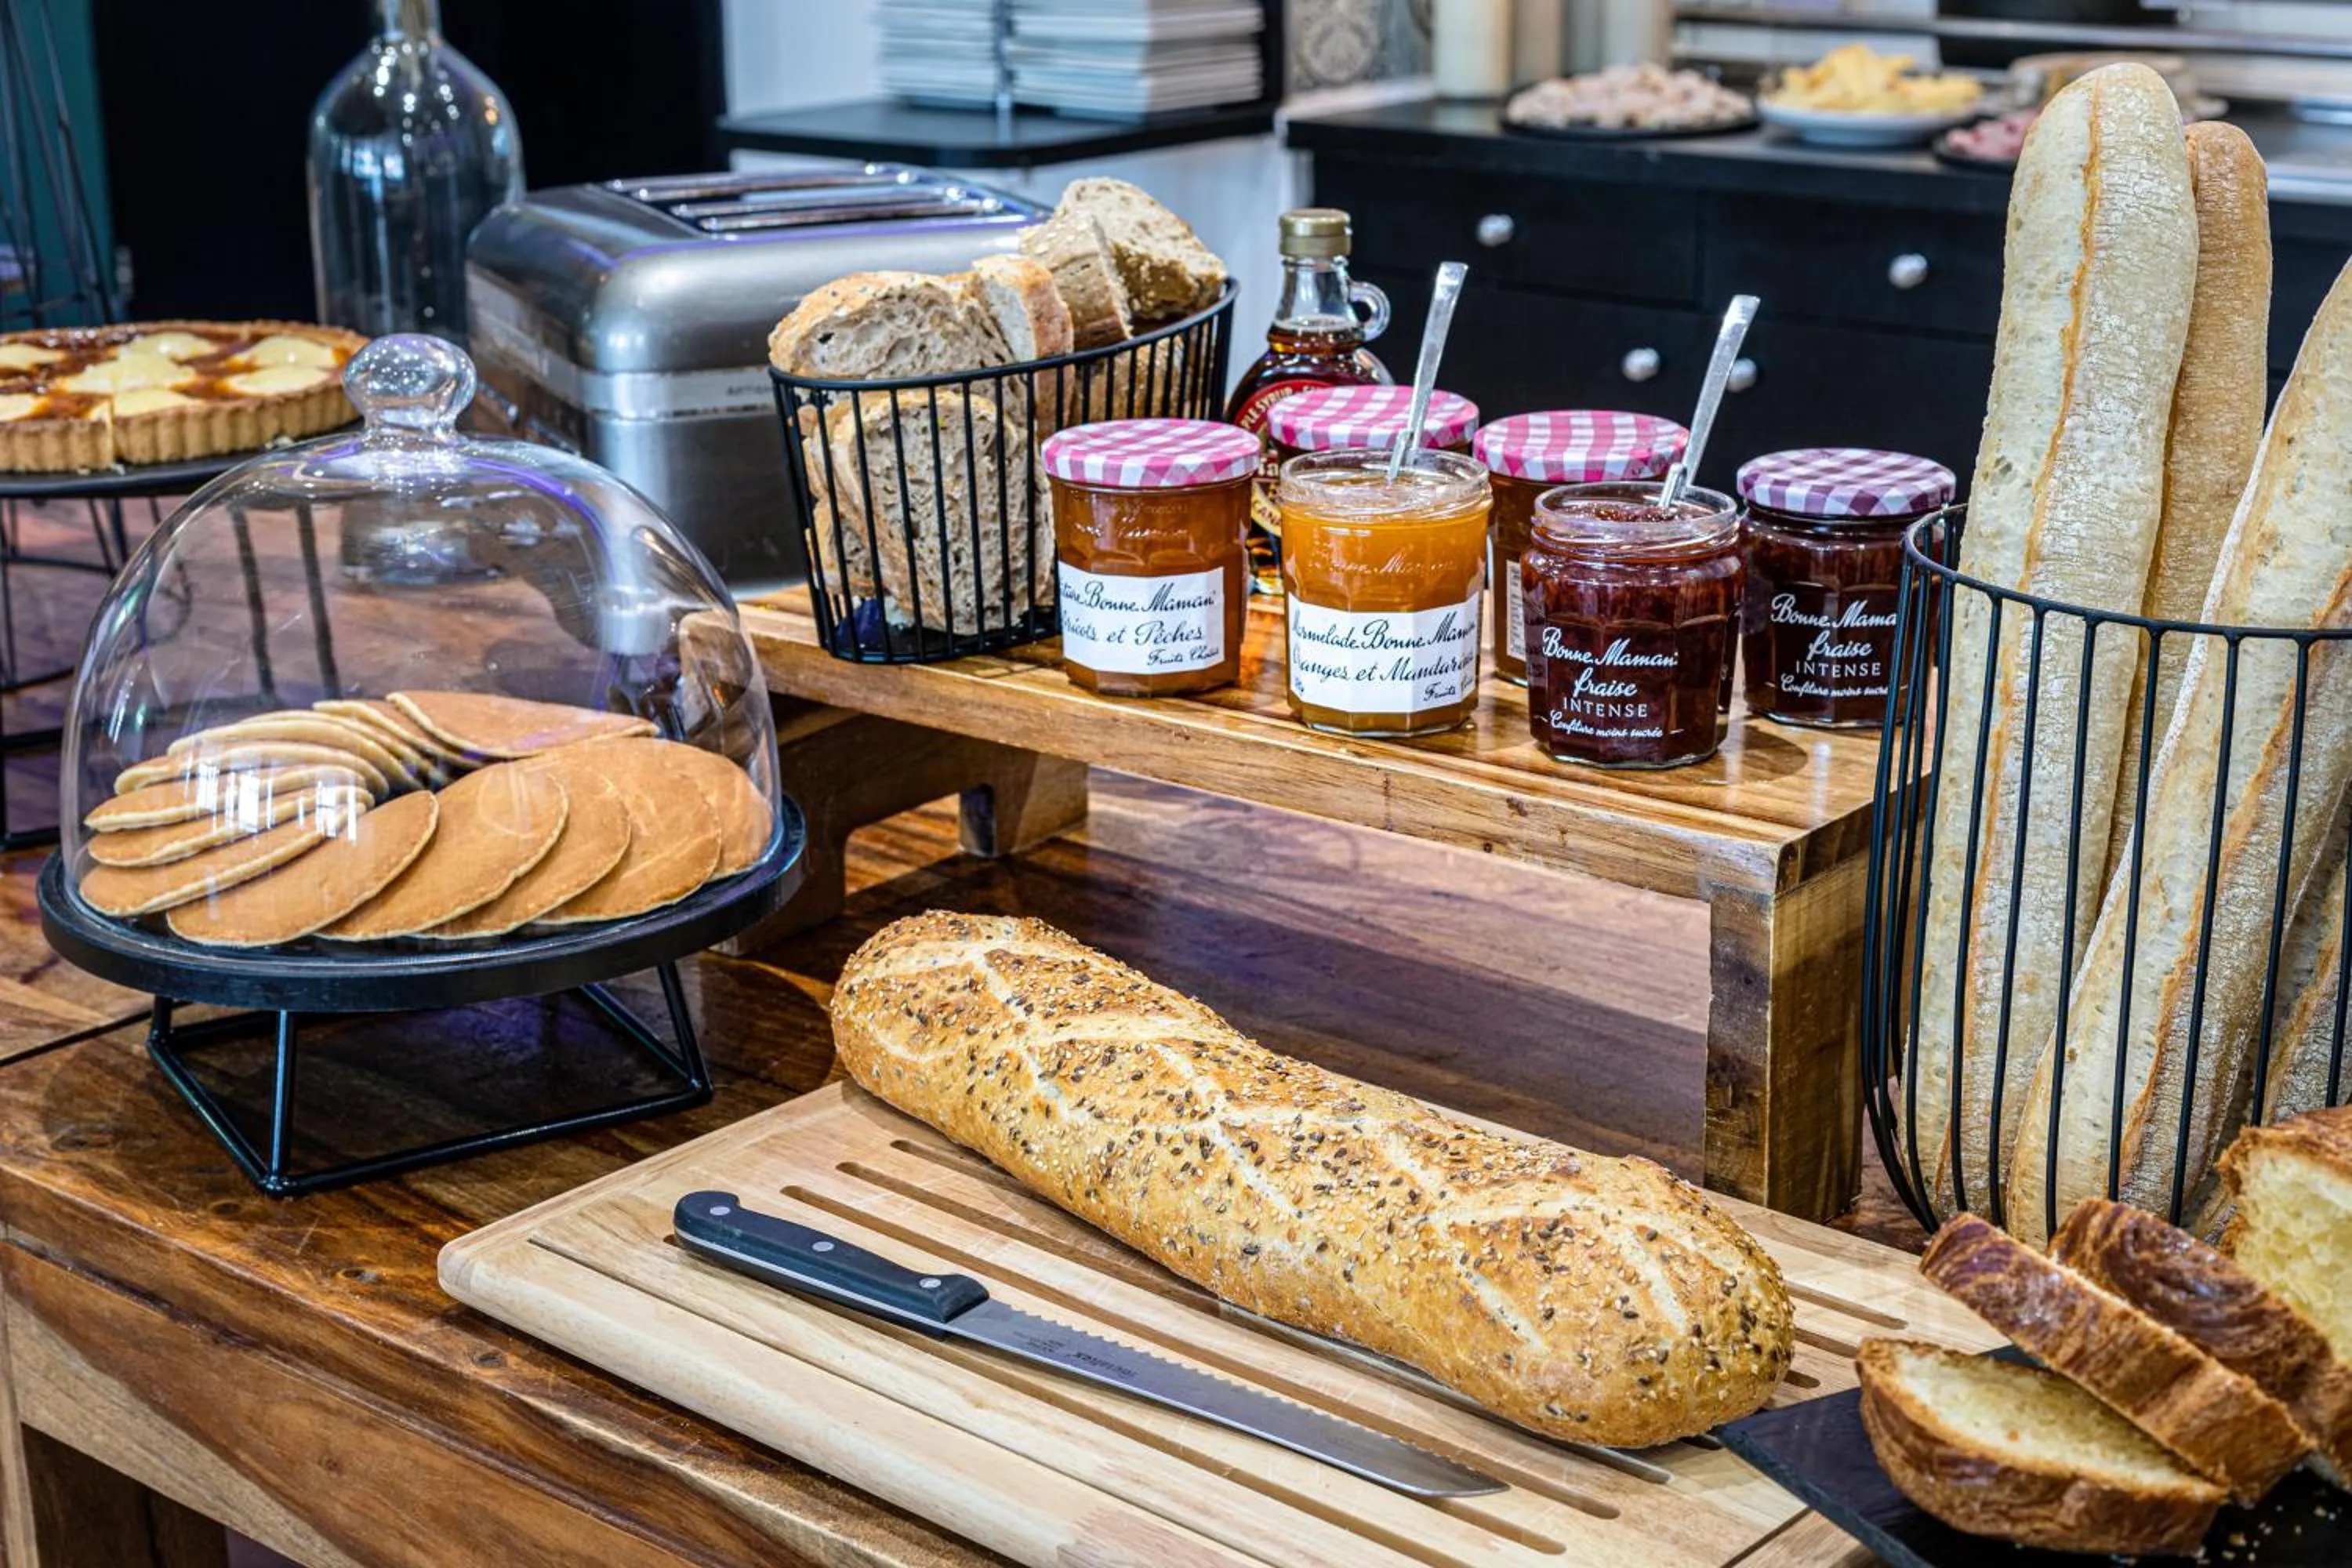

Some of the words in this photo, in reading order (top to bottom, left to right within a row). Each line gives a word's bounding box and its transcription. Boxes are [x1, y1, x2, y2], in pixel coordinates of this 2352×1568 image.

[1240, 407, 1260, 429] PLE
[1084, 580, 1139, 612] Bonne
[1141, 582, 1214, 612] Maman
[1770, 593, 1831, 627] Bonne
[1831, 599, 1898, 628] Mama
[1106, 626, 1125, 644] et
[1134, 620, 1204, 645] Pêches
[1359, 619, 1426, 650] Bonne
[1542, 626, 1593, 663] Bonne
[1594, 637, 1676, 666] Maman
[1354, 663, 1378, 681] et
[1795, 659, 1882, 678] INTENSE
[1780, 673, 1829, 697] Confiture
[1831, 686, 1862, 697] moins
[1563, 697, 1647, 717] INTENSE
[1550, 710, 1594, 735] Confiture
[1595, 728, 1628, 737] moins
[1630, 727, 1664, 738] sucrée
